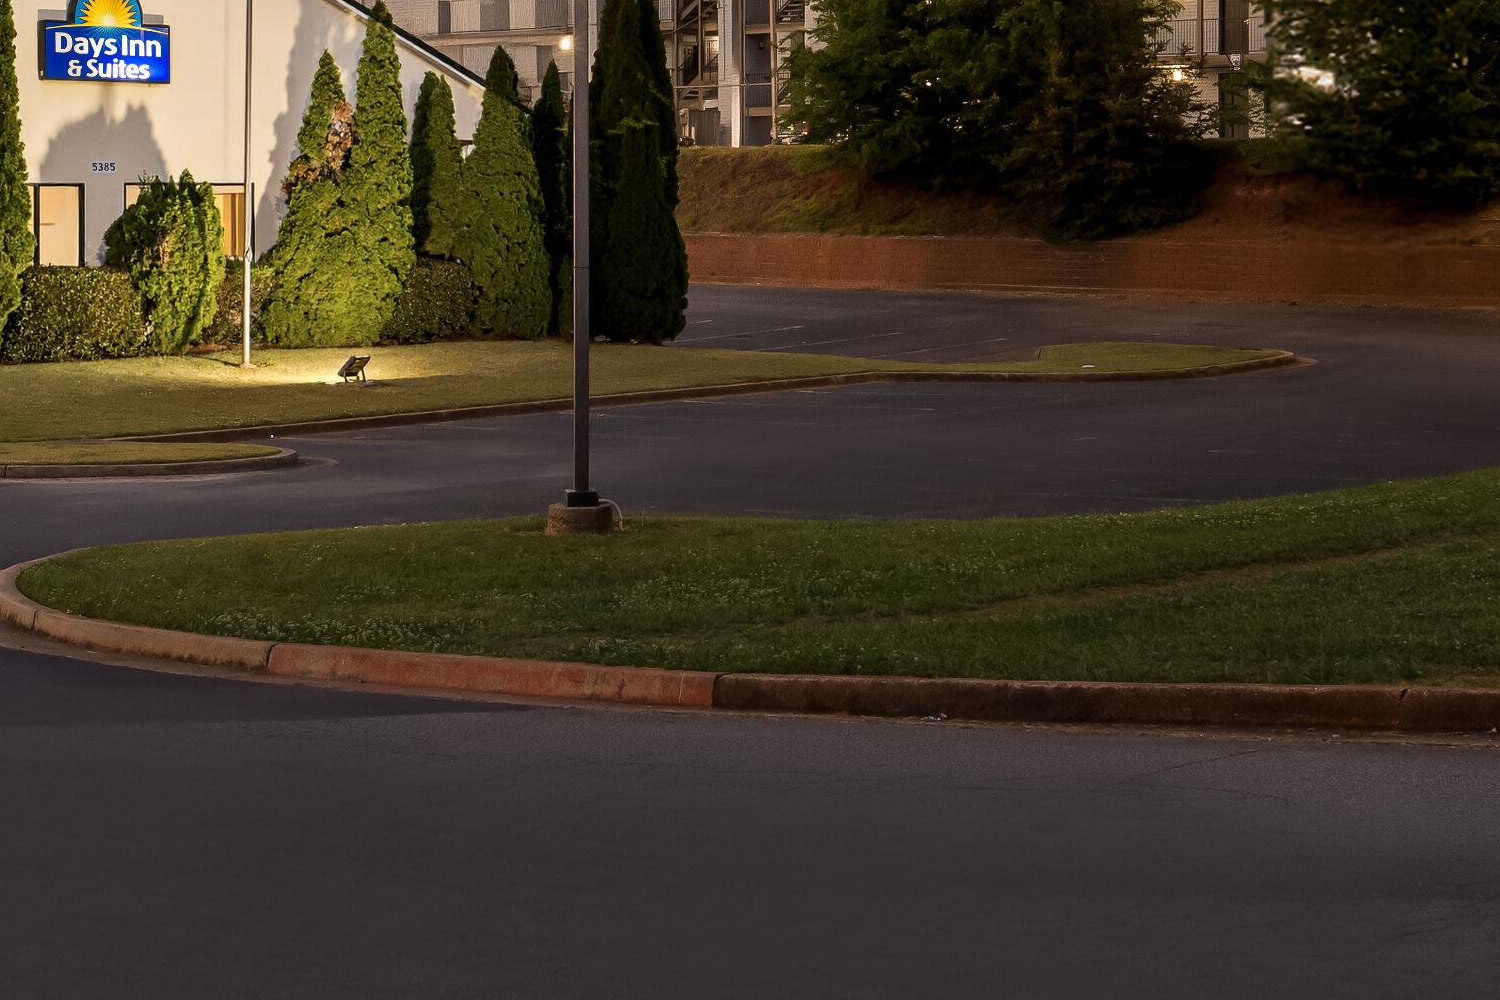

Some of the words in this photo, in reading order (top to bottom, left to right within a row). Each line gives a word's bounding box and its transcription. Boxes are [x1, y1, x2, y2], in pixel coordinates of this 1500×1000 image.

[55, 32, 117, 57] Days
[121, 35, 161, 58] Inn
[68, 60, 82, 77] &
[86, 58, 150, 79] Suites
[92, 162, 116, 172] 5385
